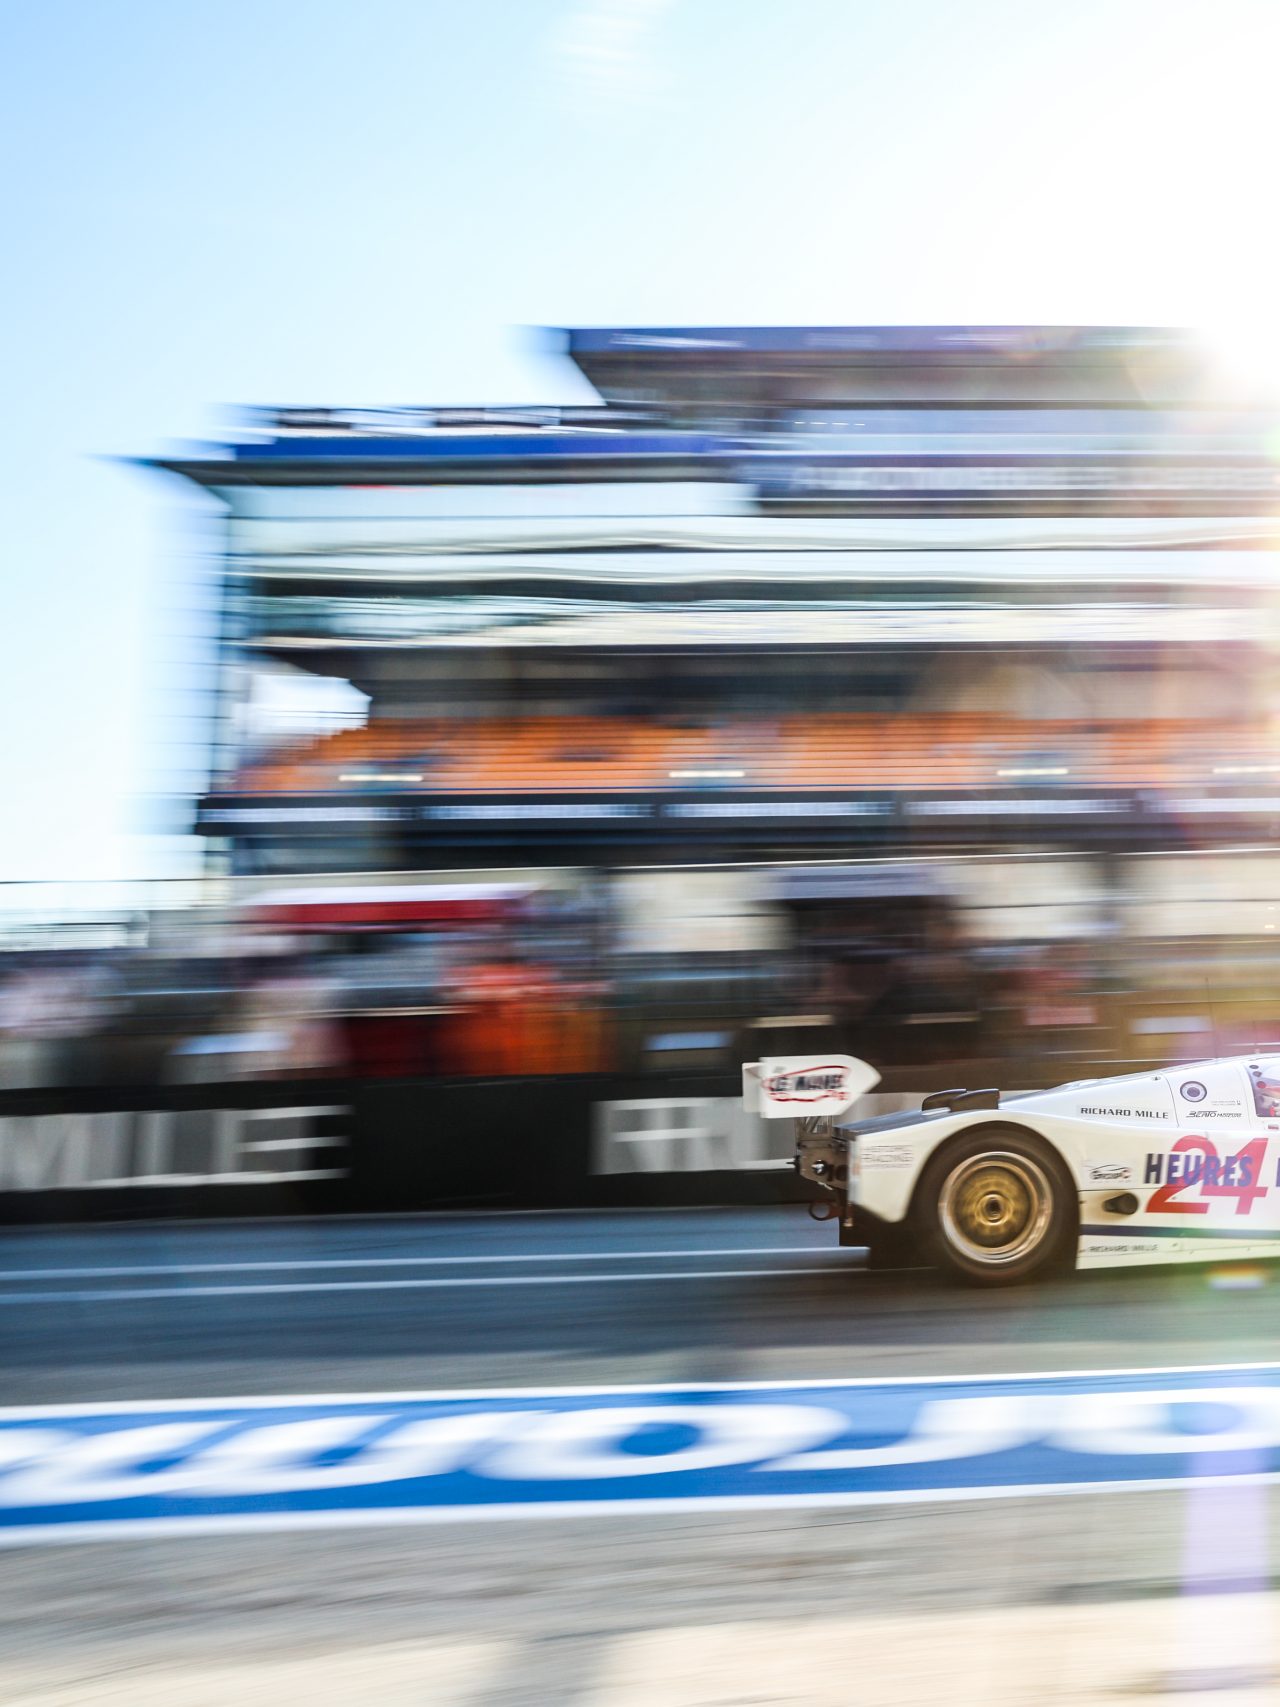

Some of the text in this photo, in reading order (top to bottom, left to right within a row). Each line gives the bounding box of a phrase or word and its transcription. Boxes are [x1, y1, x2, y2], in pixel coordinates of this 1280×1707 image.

[1080, 1107, 1169, 1119] RICHARD MILLE
[1144, 1153, 1254, 1188] HEURES
[1145, 1135, 1269, 1215] 24
